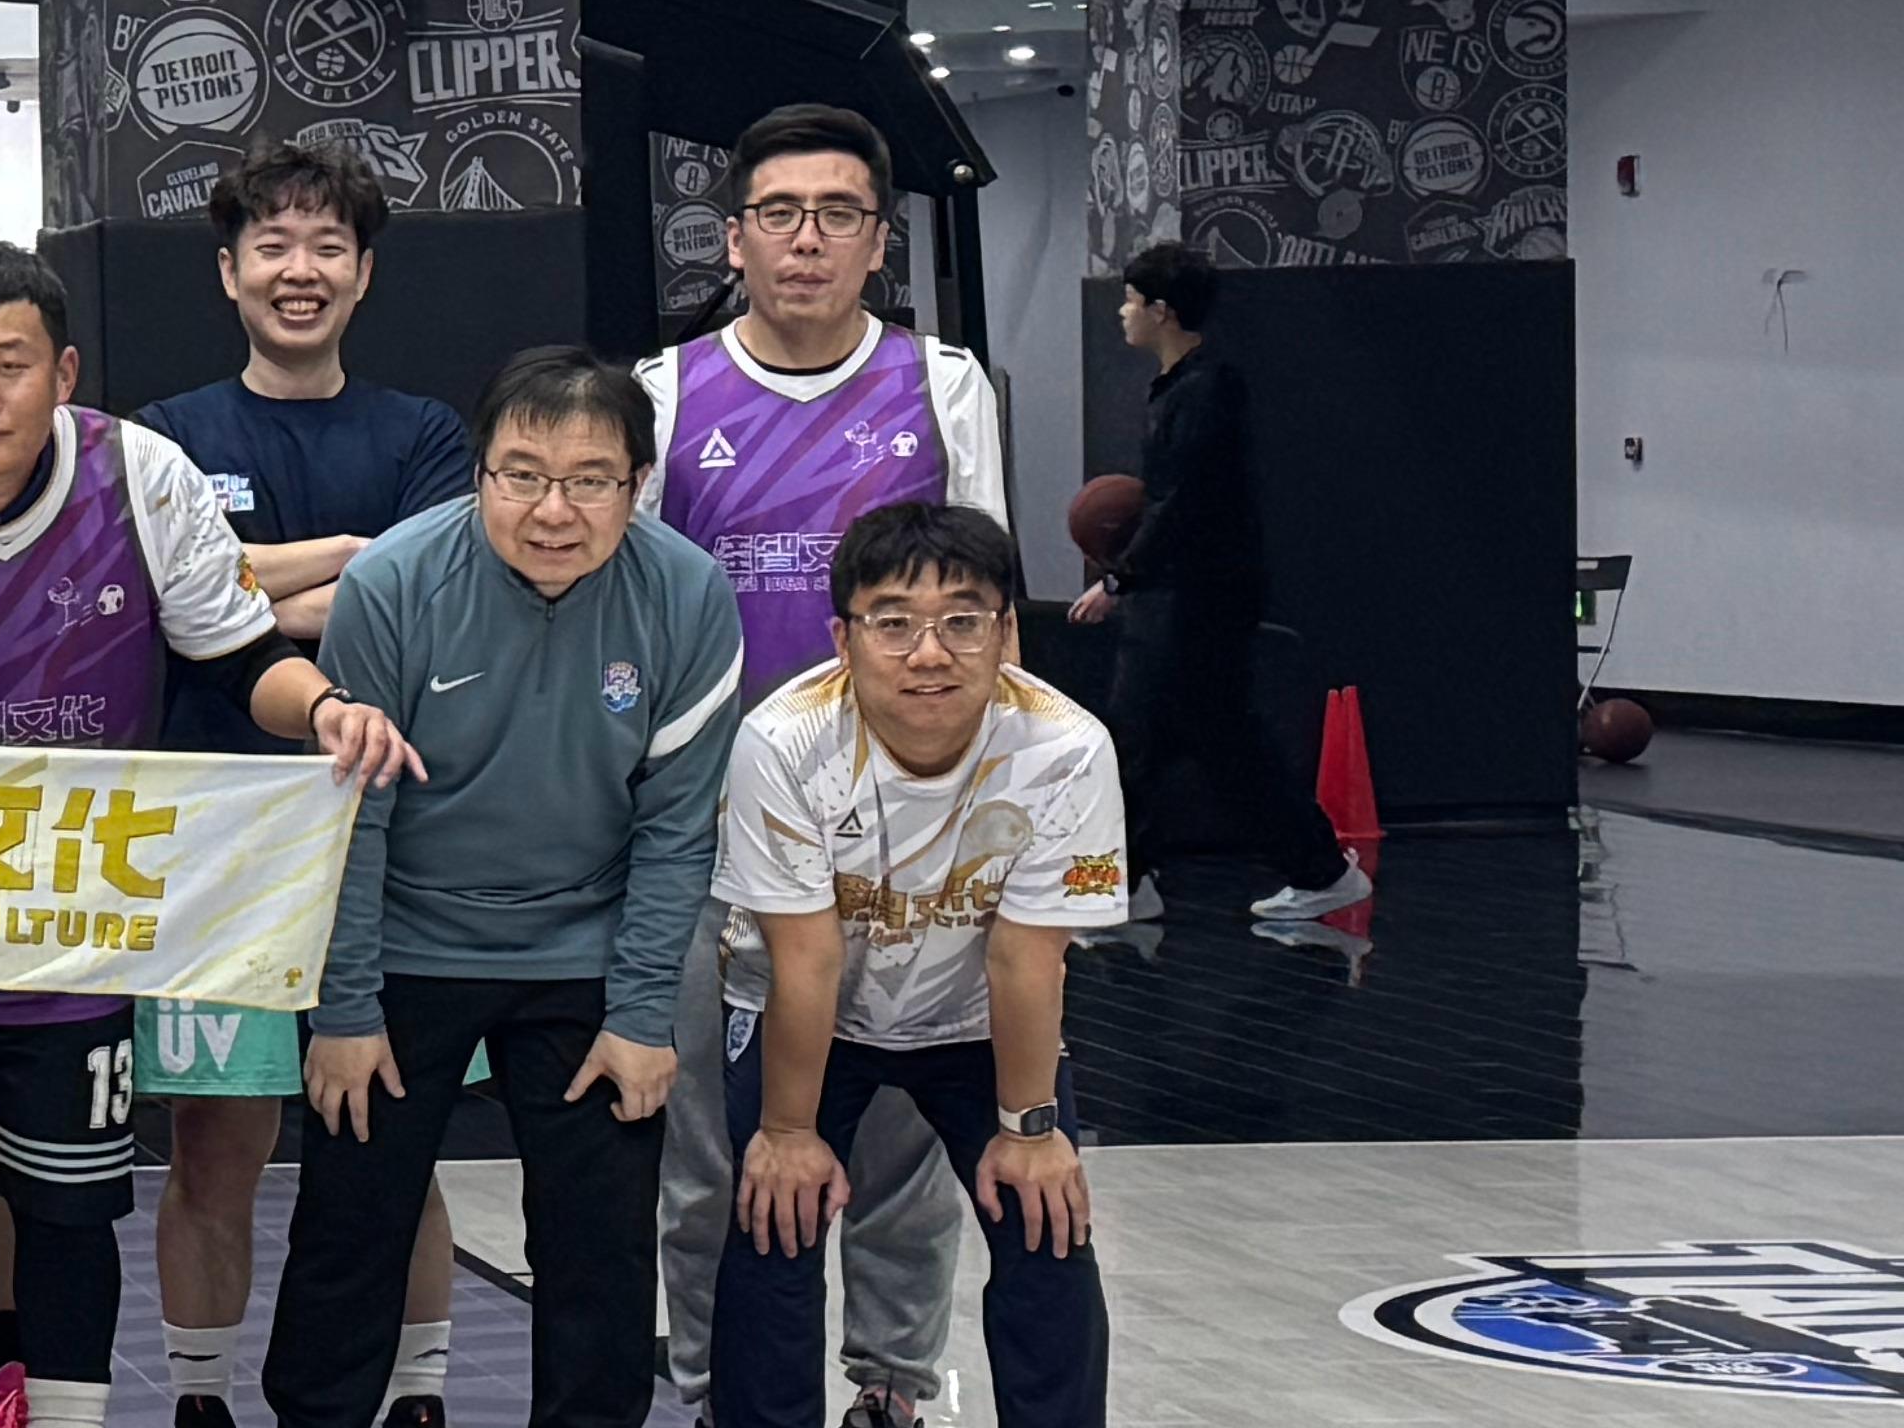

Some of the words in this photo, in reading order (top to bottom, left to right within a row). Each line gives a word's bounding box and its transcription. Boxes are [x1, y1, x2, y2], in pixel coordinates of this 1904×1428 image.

[151, 48, 240, 82] DETROIT
[154, 74, 245, 110] PISTONS
[444, 109, 522, 144] GOLDEN
[528, 116, 573, 165] STATE
[713, 531, 846, 574] 佳智文
[87, 1038, 133, 1129] 13
